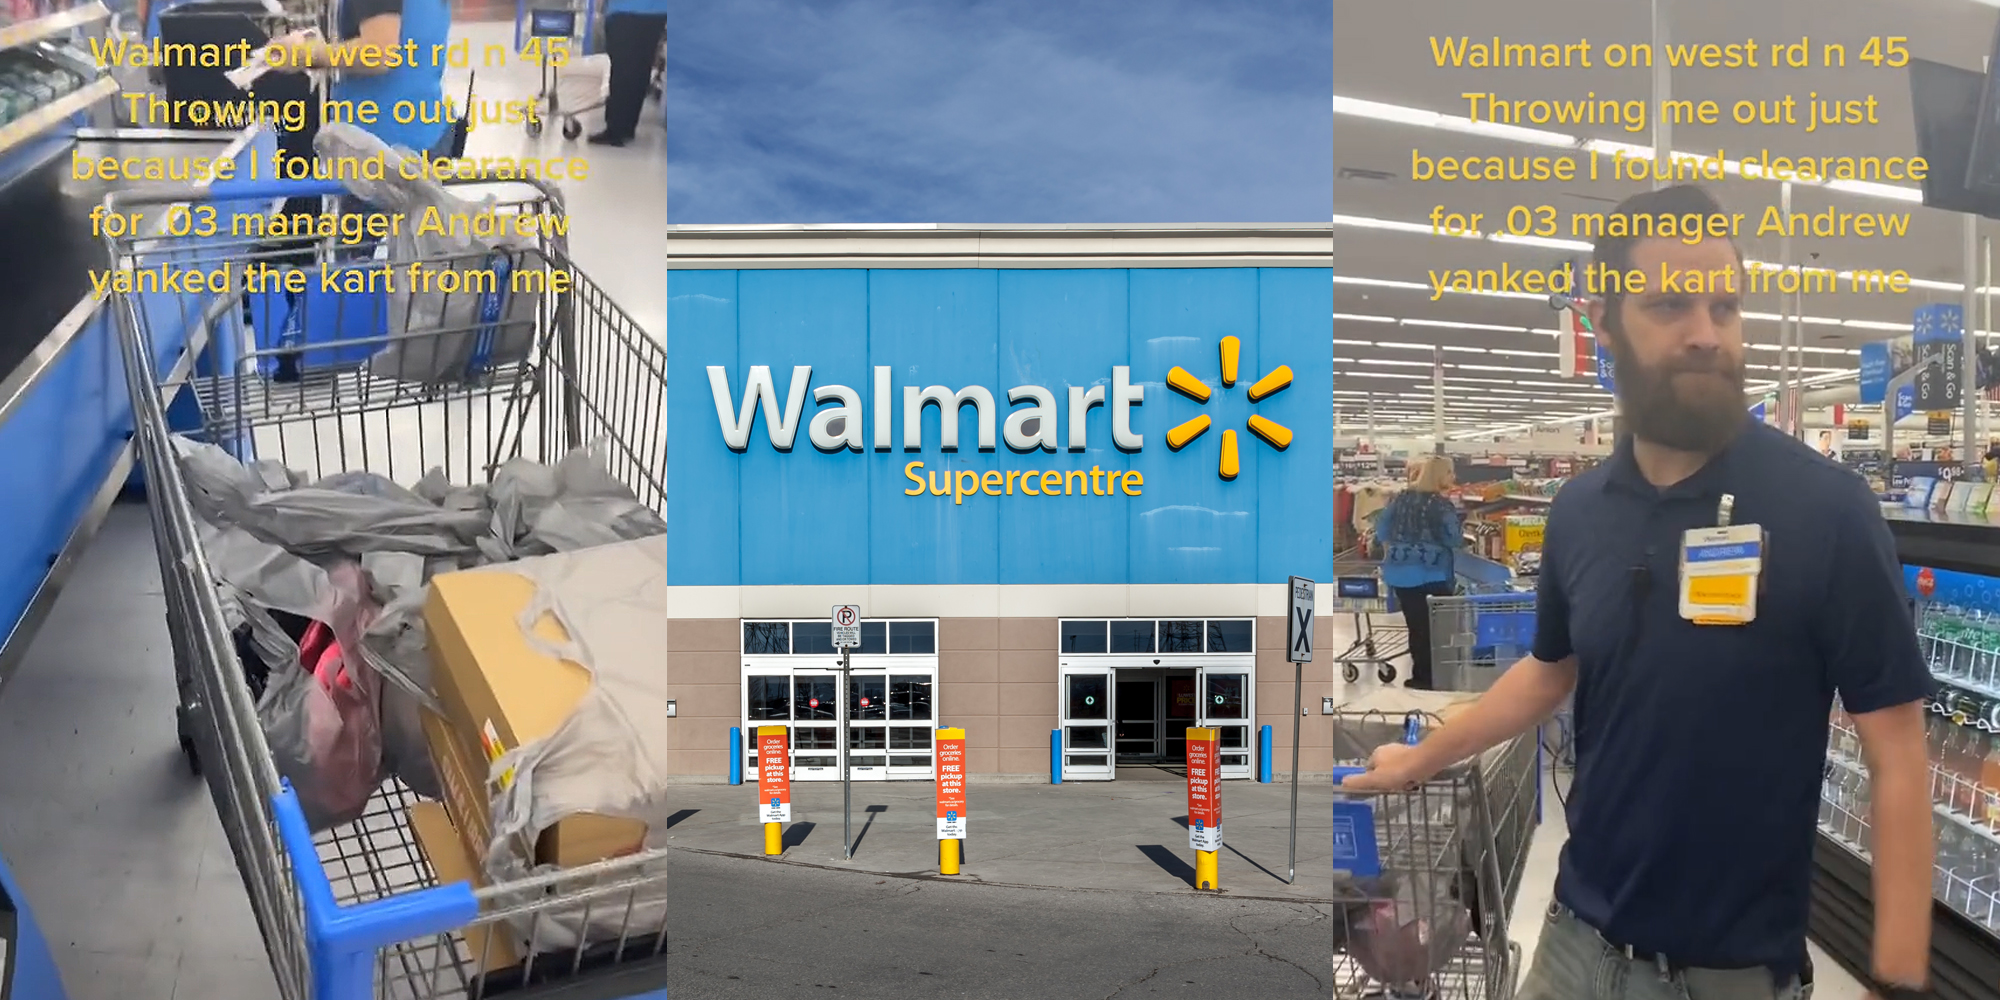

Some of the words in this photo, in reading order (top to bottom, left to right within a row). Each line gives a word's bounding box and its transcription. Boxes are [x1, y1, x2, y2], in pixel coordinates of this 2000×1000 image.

[1946, 343, 1957, 370] Scan
[1946, 372, 1956, 381] &
[1945, 382, 1956, 399] Go
[706, 365, 1144, 451] Walmart
[904, 461, 1144, 505] Supercentre
[1294, 606, 1313, 653] X
[1190, 777, 1208, 786] pickup
[1191, 768, 1206, 776] FREE
